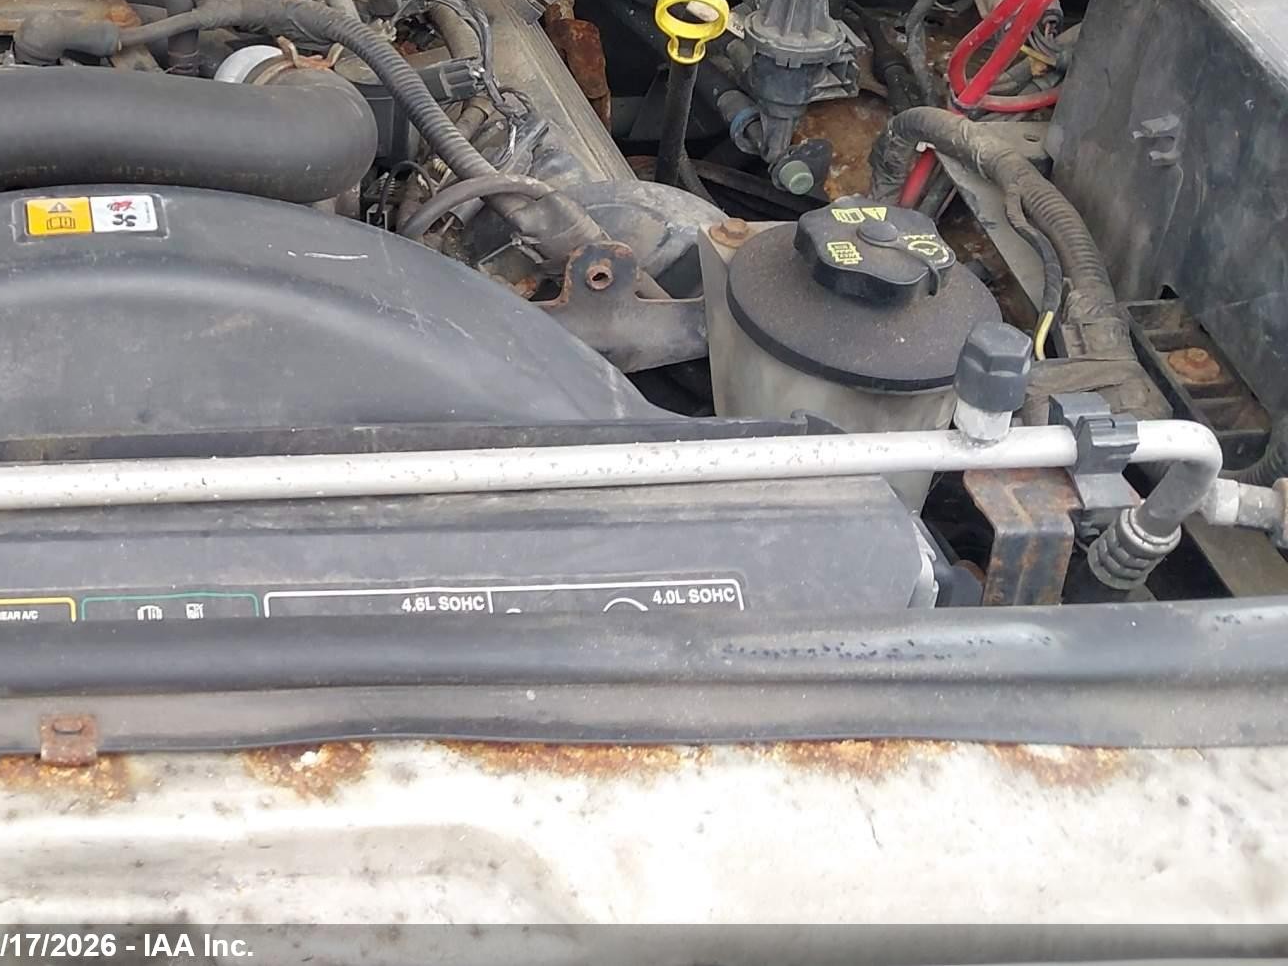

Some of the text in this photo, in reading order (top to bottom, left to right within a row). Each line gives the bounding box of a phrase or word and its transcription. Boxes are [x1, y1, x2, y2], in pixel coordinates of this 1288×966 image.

[402, 595, 485, 612] 4.6L SOHC
[652, 587, 736, 605] 4.0L SOHC
[22, 610, 39, 620] A/C
